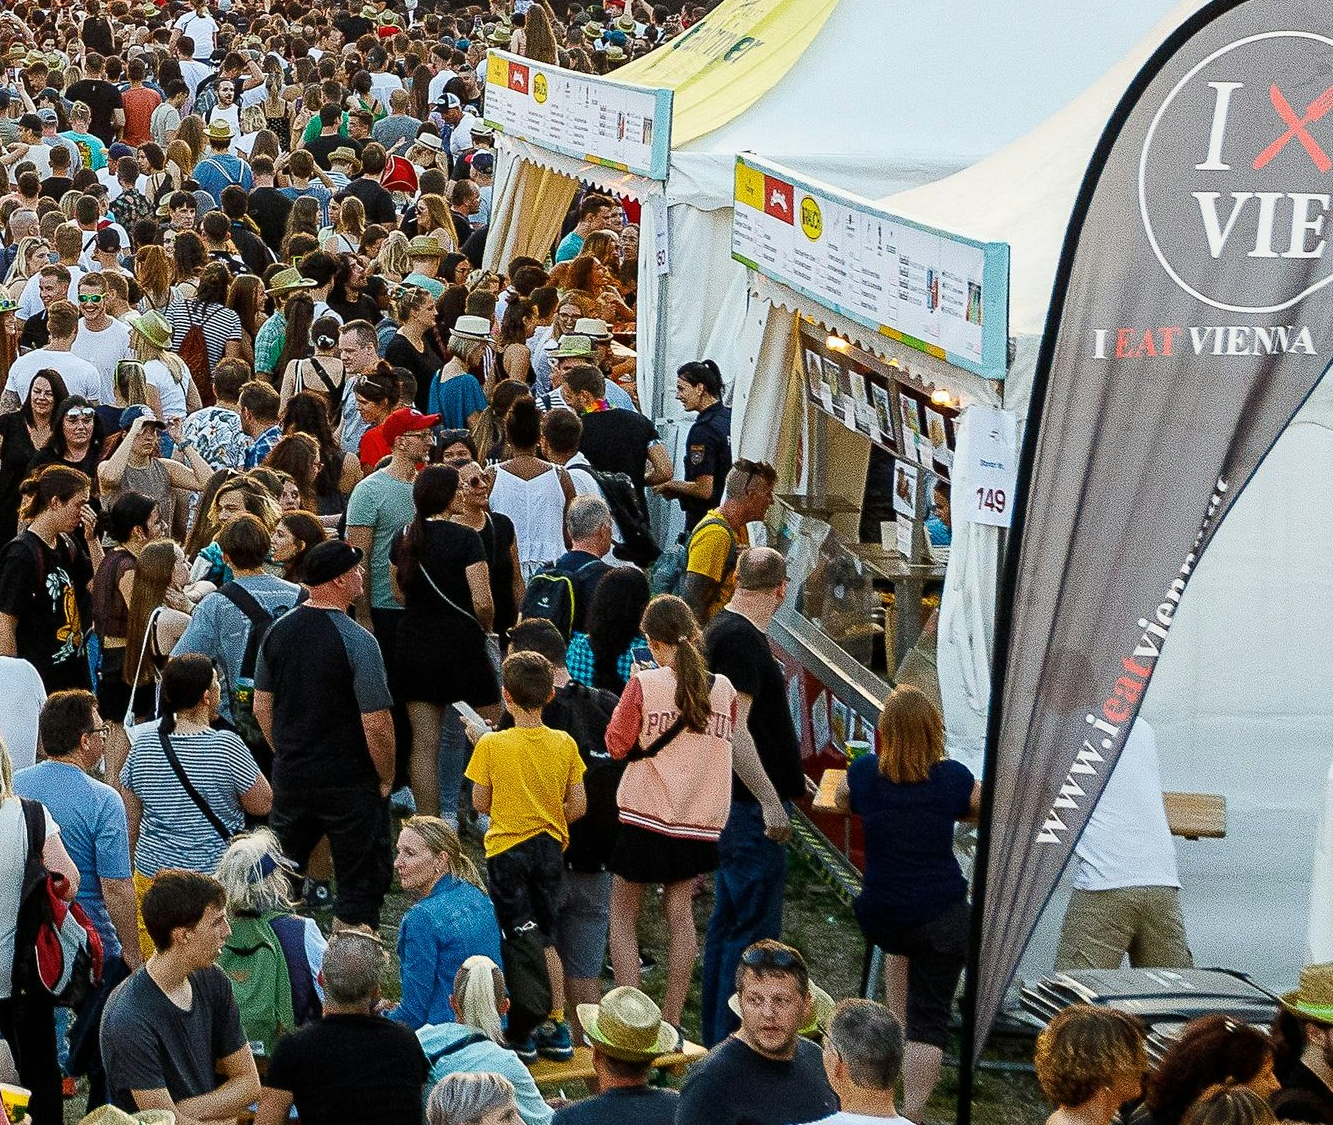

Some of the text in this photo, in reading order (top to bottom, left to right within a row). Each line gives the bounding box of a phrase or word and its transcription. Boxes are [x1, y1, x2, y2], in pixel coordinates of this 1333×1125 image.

[1194, 82, 1244, 172] I
[1092, 325, 1318, 360] I EAT VIENNA
[976, 487, 1006, 513] 149
